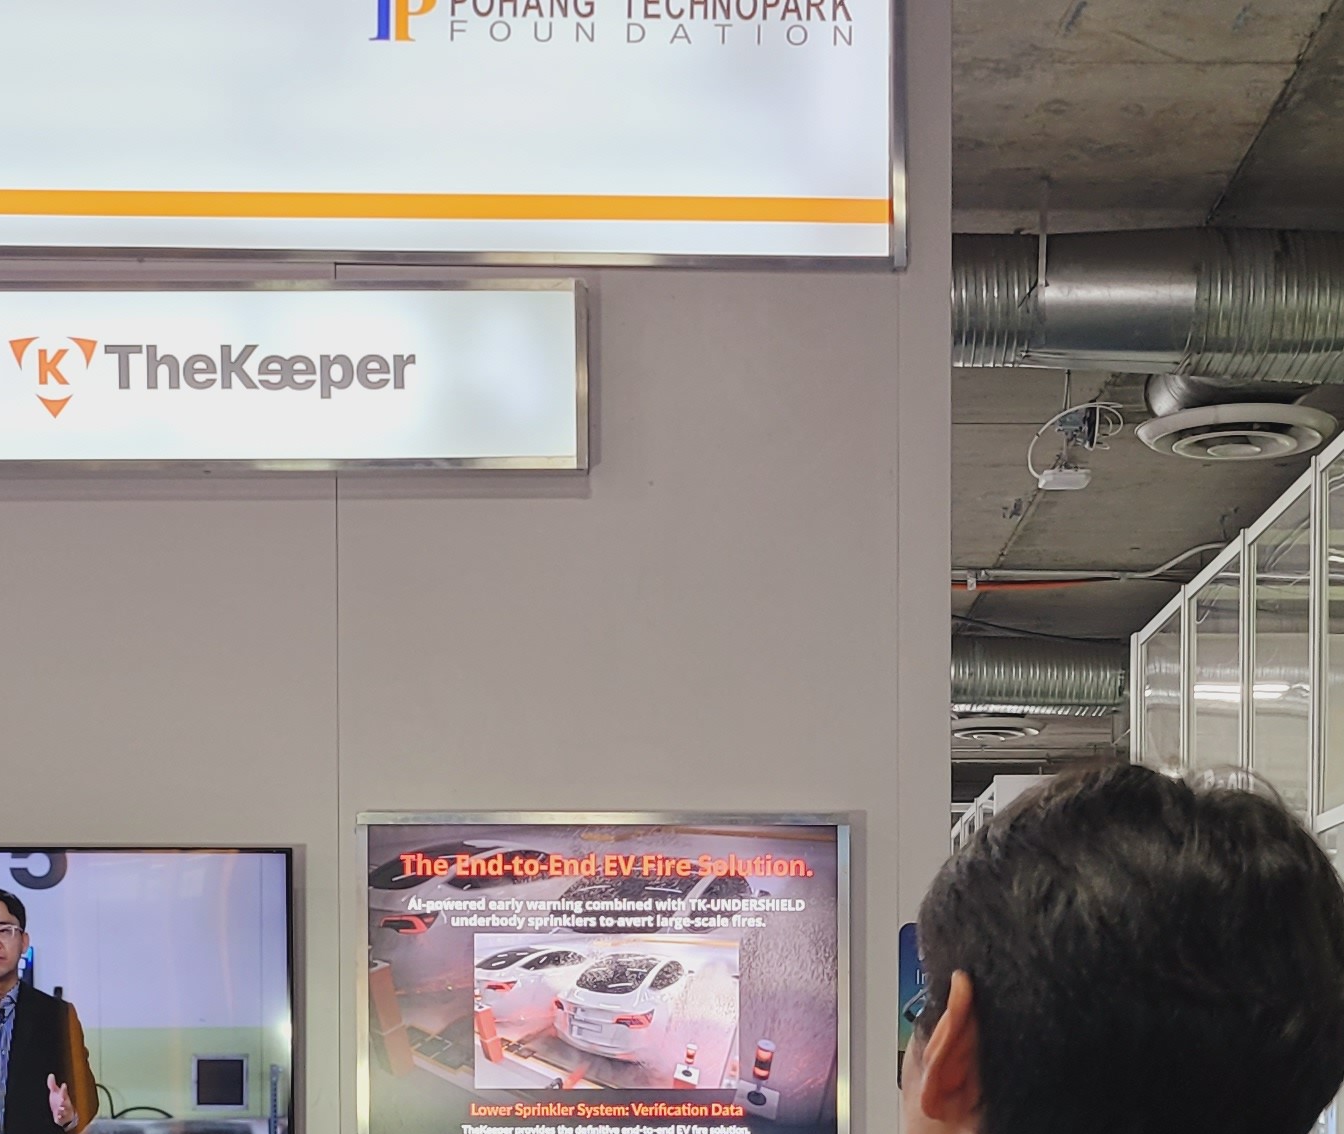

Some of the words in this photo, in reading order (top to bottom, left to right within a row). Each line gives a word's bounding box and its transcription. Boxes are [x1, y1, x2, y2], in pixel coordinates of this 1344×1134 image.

[450, 20, 854, 47] FOUNDATION
[104, 344, 416, 399] TheKeeper
[400, 853, 449, 877] The
[455, 853, 598, 877] End-to-End
[604, 854, 637, 877] EV
[642, 853, 692, 877] Fire
[698, 853, 815, 878] Solution.
[488, 898, 524, 914] early
[525, 897, 583, 914] warning
[585, 896, 656, 912] combined
[656, 897, 687, 912] with
[688, 898, 806, 912] TK-UNDERSHIELD
[450, 913, 525, 929] underbody
[527, 913, 598, 929] sprinklers
[656, 914, 729, 930] large-scale
[731, 914, 767, 928] fires.
[470, 1103, 513, 1117] Lower
[514, 1102, 575, 1119] Sprinkler
[577, 1103, 630, 1119] System:
[631, 1102, 709, 1117] Verification
[711, 1103, 744, 1117] Data
